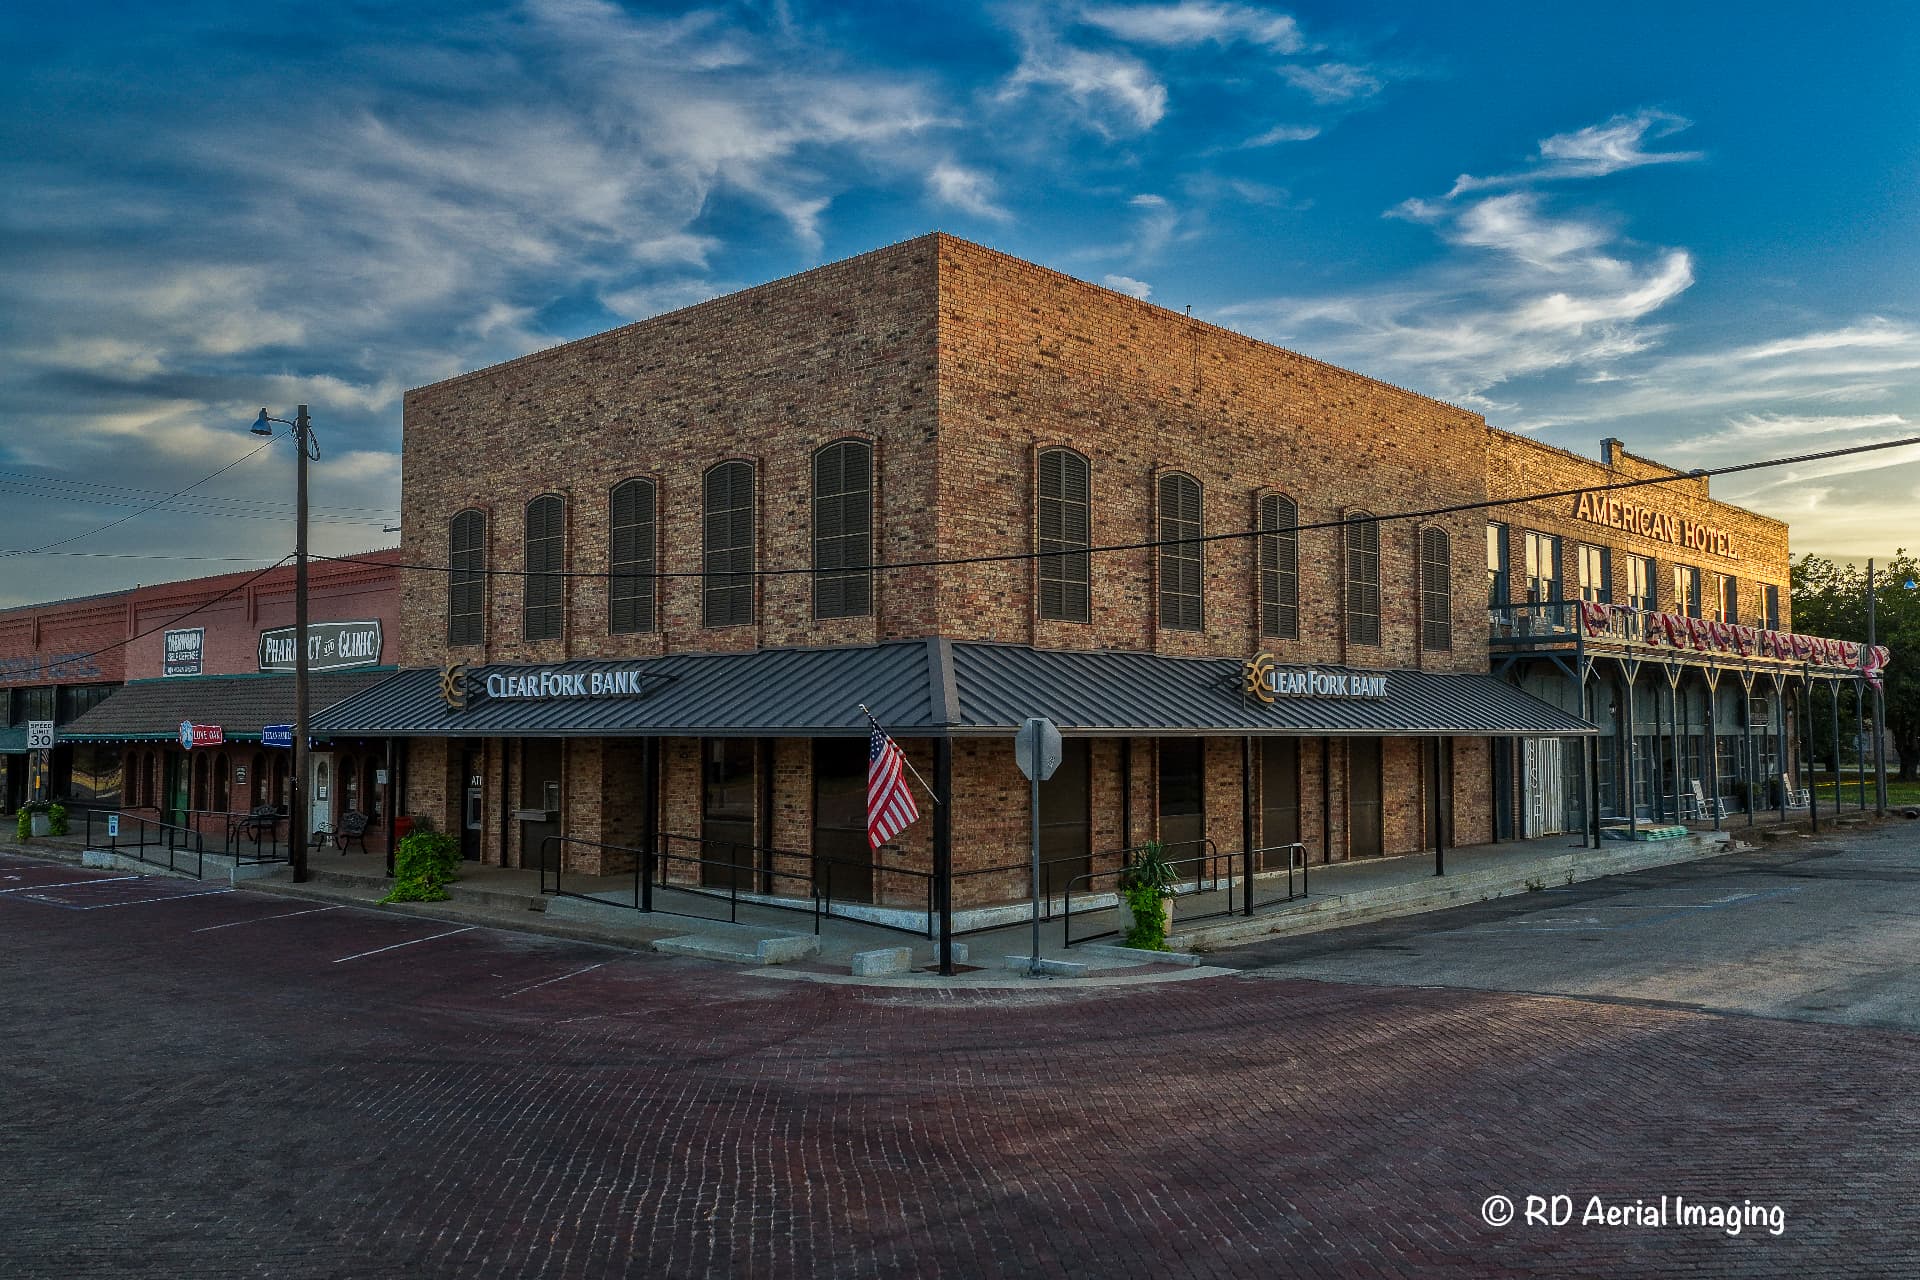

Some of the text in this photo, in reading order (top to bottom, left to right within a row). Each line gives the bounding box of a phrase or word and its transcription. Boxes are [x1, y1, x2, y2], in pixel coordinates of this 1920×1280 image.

[1576, 491, 1739, 561] AMERICAN HOTEL
[265, 636, 322, 663] PHARCY
[338, 630, 375, 658] CLINIC
[591, 670, 643, 696] BANK
[1350, 675, 1388, 697] BANK
[30, 735, 51, 746] 30
